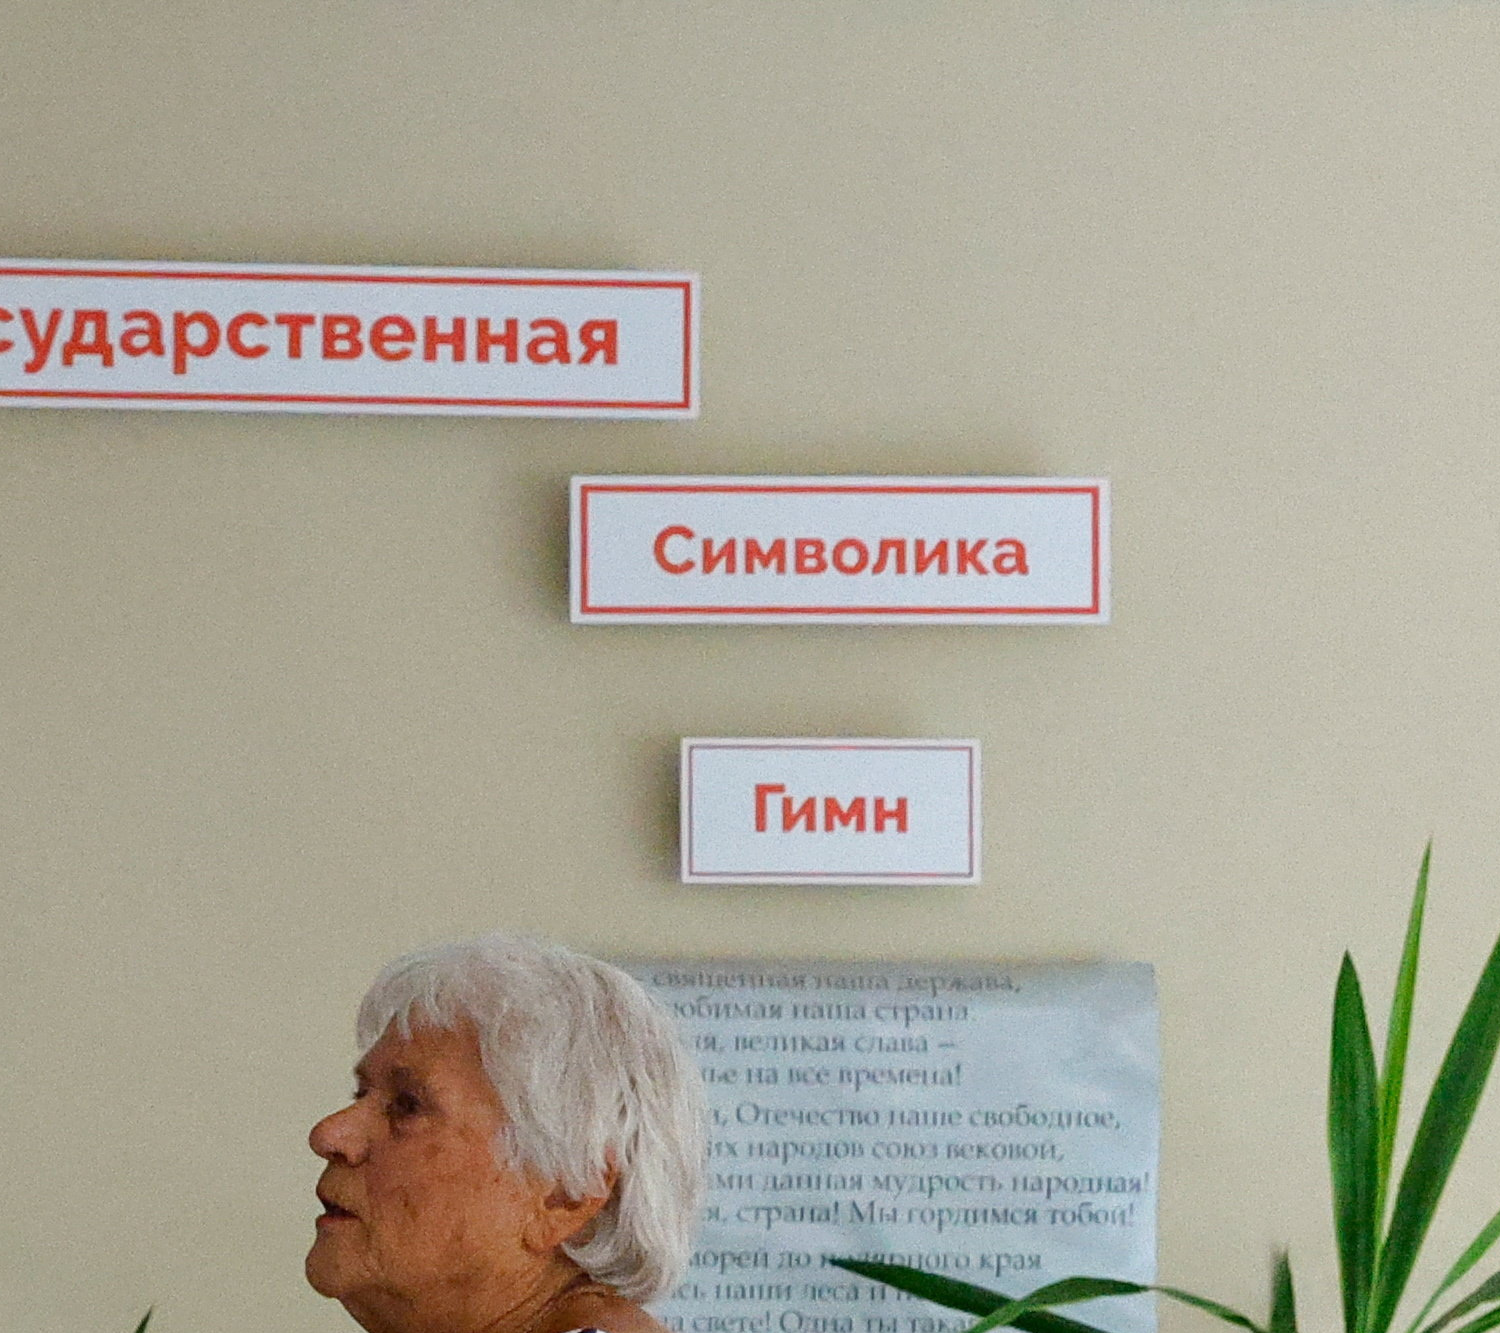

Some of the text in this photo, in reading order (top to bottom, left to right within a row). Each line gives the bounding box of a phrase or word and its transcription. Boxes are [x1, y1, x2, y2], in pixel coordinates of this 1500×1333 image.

[652, 523, 1031, 578] Символика
[753, 782, 911, 834] Гимн
[813, 973, 890, 990] наша
[898, 974, 1021, 998] держава,
[674, 995, 783, 1020] юбимая
[793, 1003, 866, 1021] наша
[735, 1036, 845, 1052] великая
[855, 1036, 929, 1053] слава
[746, 1067, 779, 1084] на
[788, 1067, 831, 1085] все
[839, 1063, 962, 1092] времена!
[735, 1102, 880, 1127] Отечество
[888, 1108, 963, 1127] наше
[969, 1104, 1121, 1131] свободное,
[747, 1140, 865, 1166] народов
[873, 1141, 940, 1160] союз
[947, 1139, 1064, 1162] вековой,
[762, 1173, 863, 1194] данная
[872, 1173, 1003, 1200] мудрость
[1012, 1172, 1150, 1201] народная!
[735, 1200, 840, 1230] страна!
[849, 1200, 899, 1224] Мы
[906, 1205, 1038, 1232] гордимся
[1049, 1201, 1134, 1227] тобой!
[778, 1251, 812, 1270] до
[979, 1251, 1043, 1278] края
[715, 1283, 793, 1302] наши
[803, 1283, 861, 1302] леса
[869, 1284, 888, 1301] и
[692, 1310, 771, 1333] свете!
[865, 1316, 898, 1333] ты
